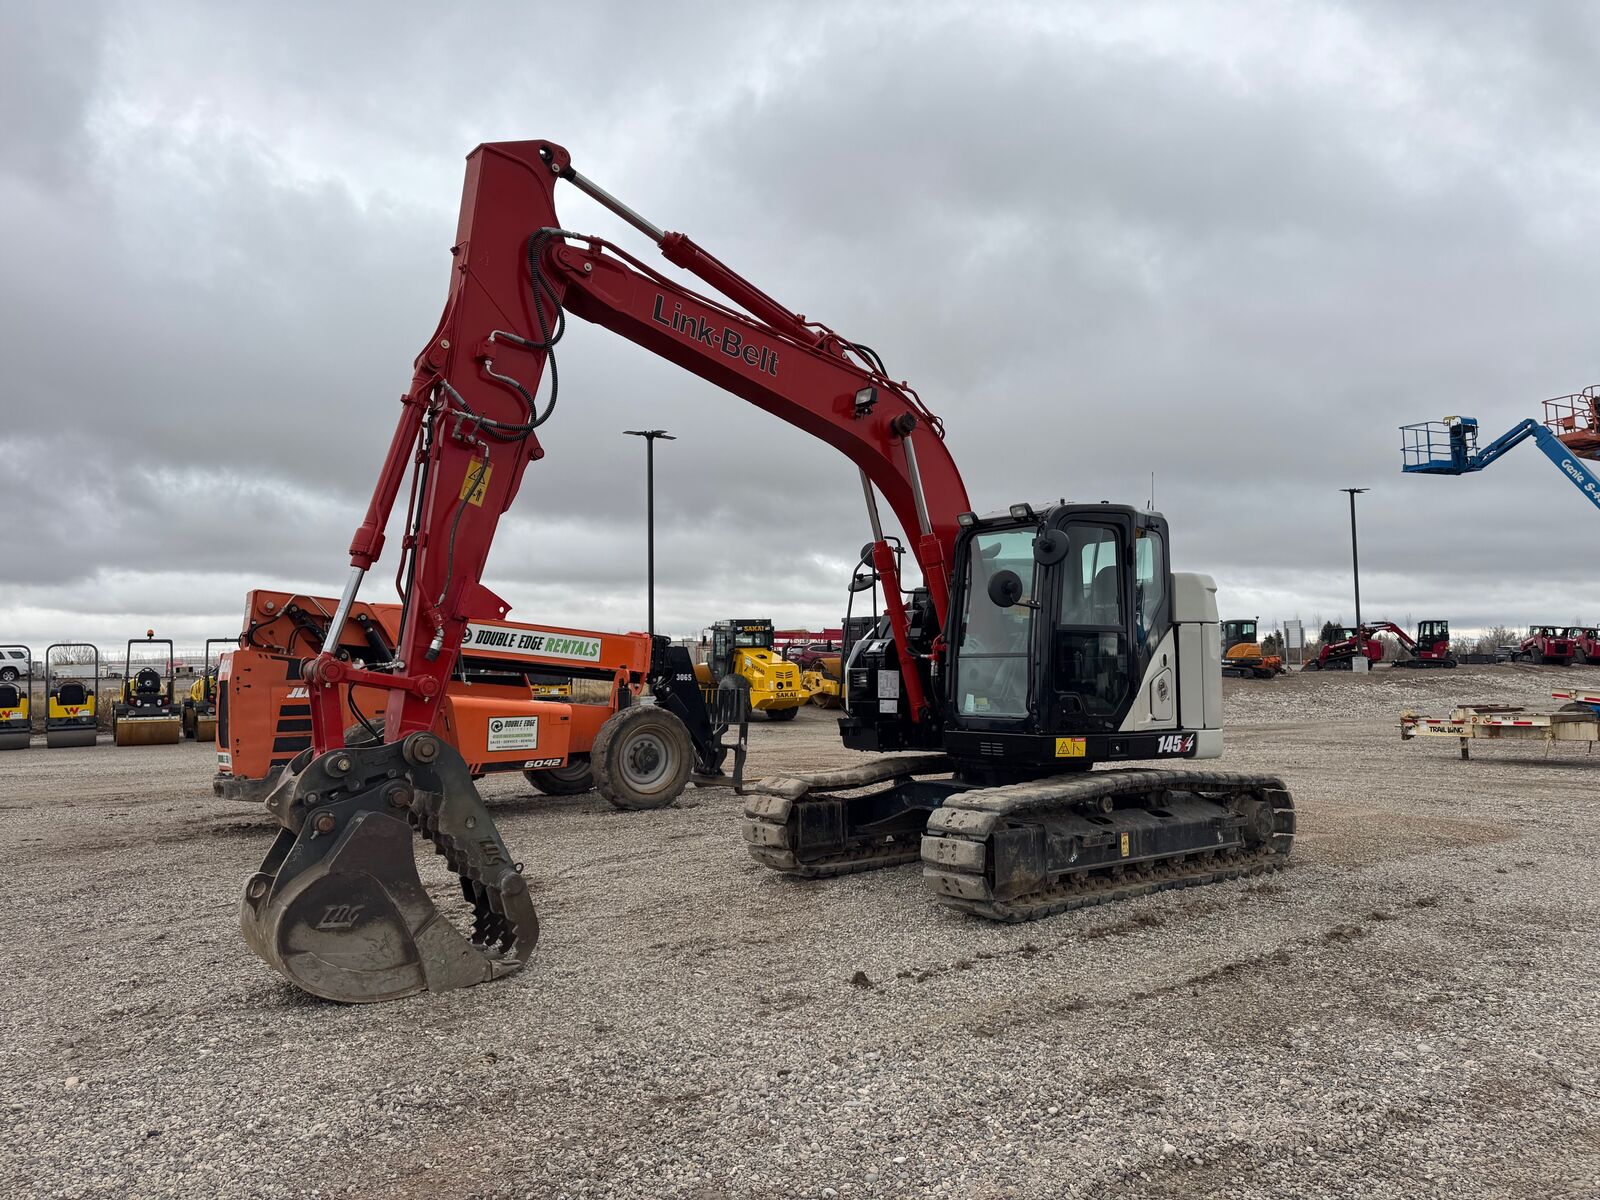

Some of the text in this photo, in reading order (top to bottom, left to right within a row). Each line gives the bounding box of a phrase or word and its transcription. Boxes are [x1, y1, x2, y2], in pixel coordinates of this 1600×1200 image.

[652, 293, 779, 377] Link-Belt
[1562, 459, 1600, 504] Genie S-4
[475, 629, 600, 657] DOUBLE EDGE RENTALS
[286, 687, 310, 698] JL
[776, 691, 797, 699] SAKAI
[524, 758, 562, 769] 6042
